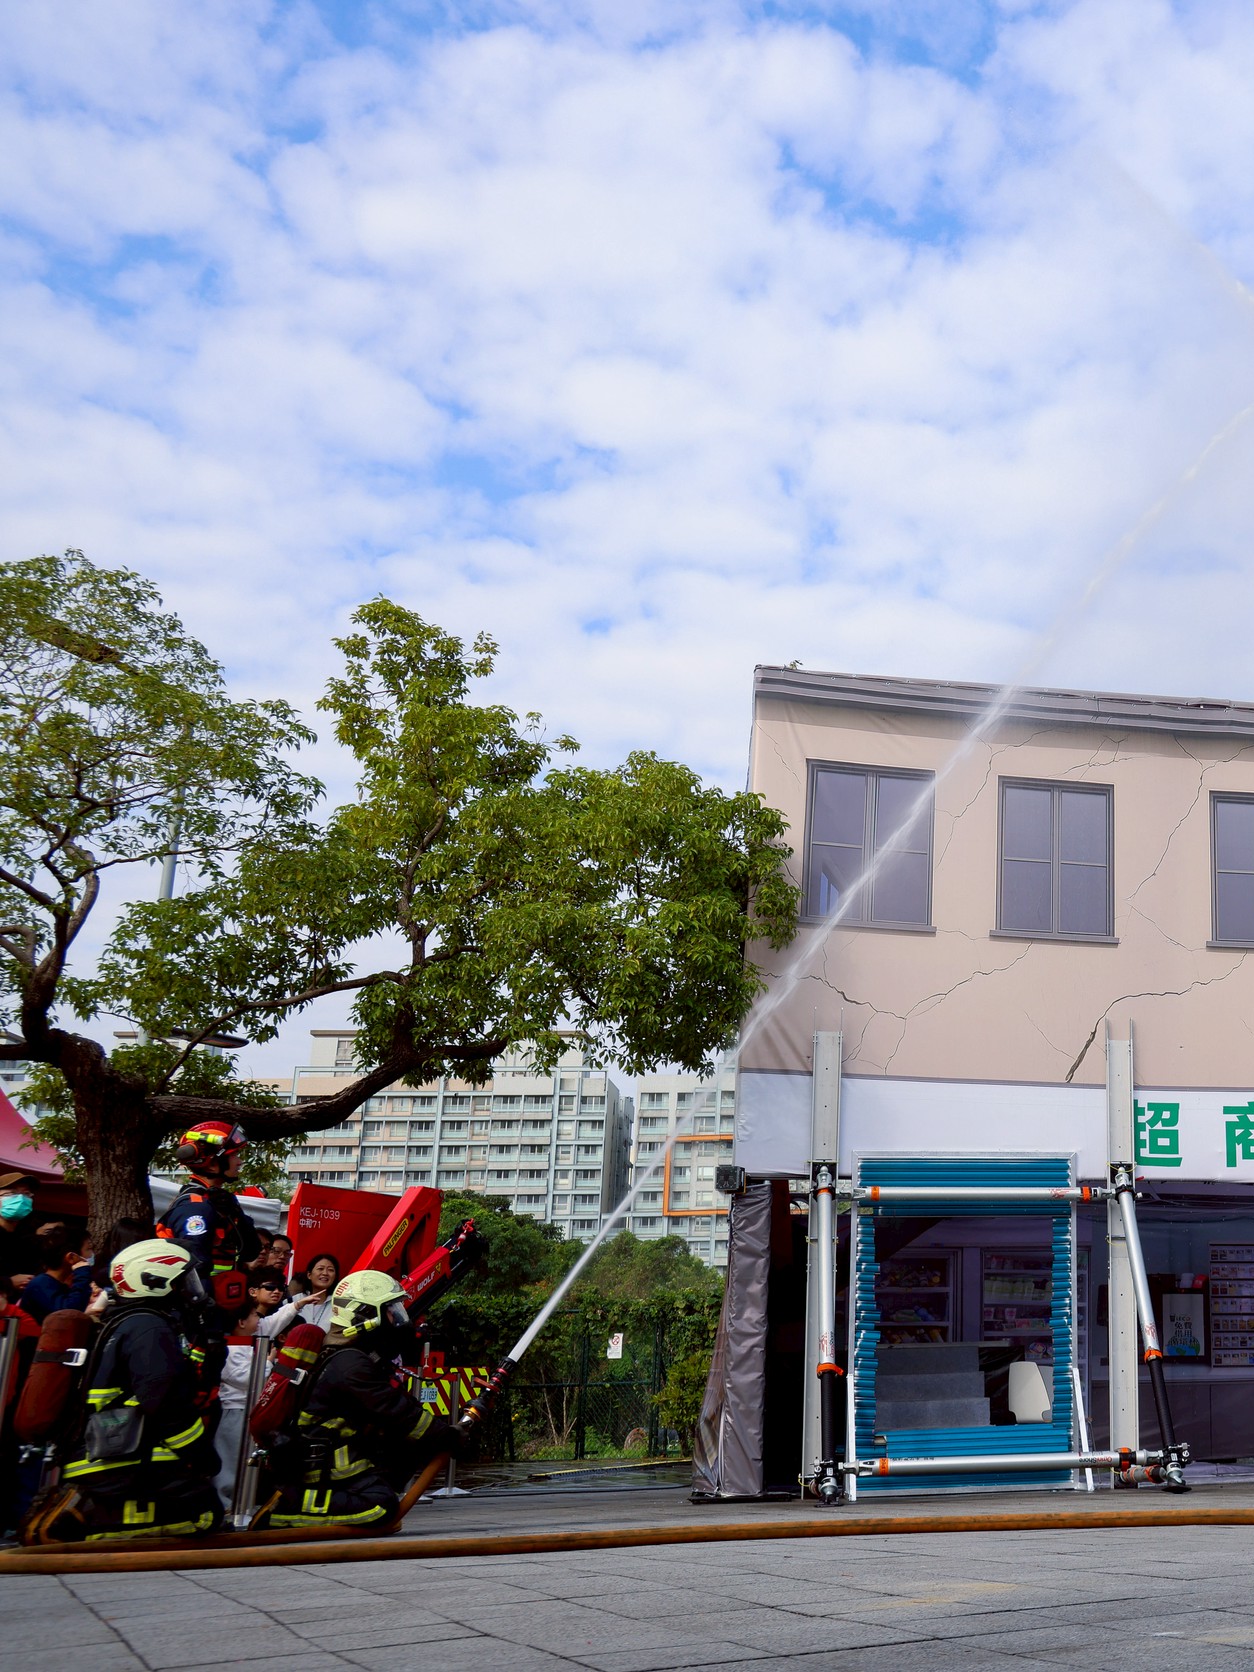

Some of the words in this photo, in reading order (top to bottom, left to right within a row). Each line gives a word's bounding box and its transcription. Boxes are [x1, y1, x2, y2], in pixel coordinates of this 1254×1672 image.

[300, 1206, 340, 1220] KEJ-1039
[384, 1220, 408, 1255] PALFINGER
[417, 1271, 435, 1291] WOLF
